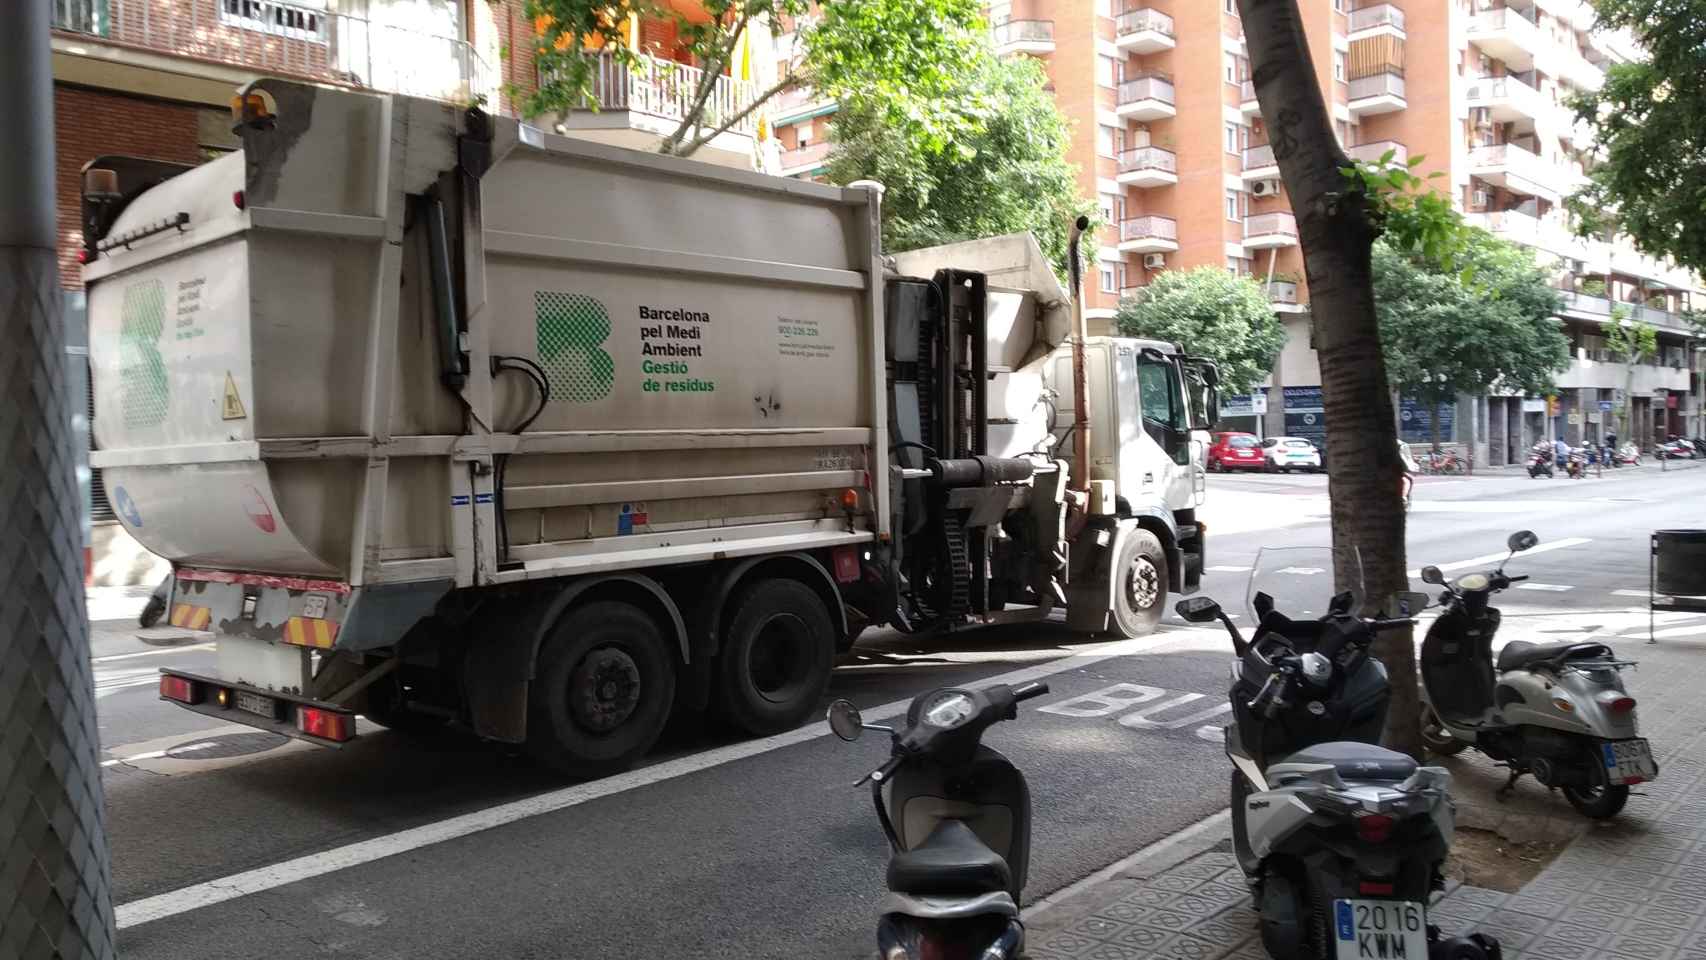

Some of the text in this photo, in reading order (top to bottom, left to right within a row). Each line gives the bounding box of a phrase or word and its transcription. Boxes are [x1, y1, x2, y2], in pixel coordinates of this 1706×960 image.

[639, 305, 710, 322] Barcelona
[640, 324, 701, 340] pel Medi
[642, 342, 702, 357] Ambient
[642, 359, 689, 374] Gestió
[642, 378, 715, 392] de residus
[1356, 905, 1420, 932] 2016
[1359, 933, 1407, 960] KWM
